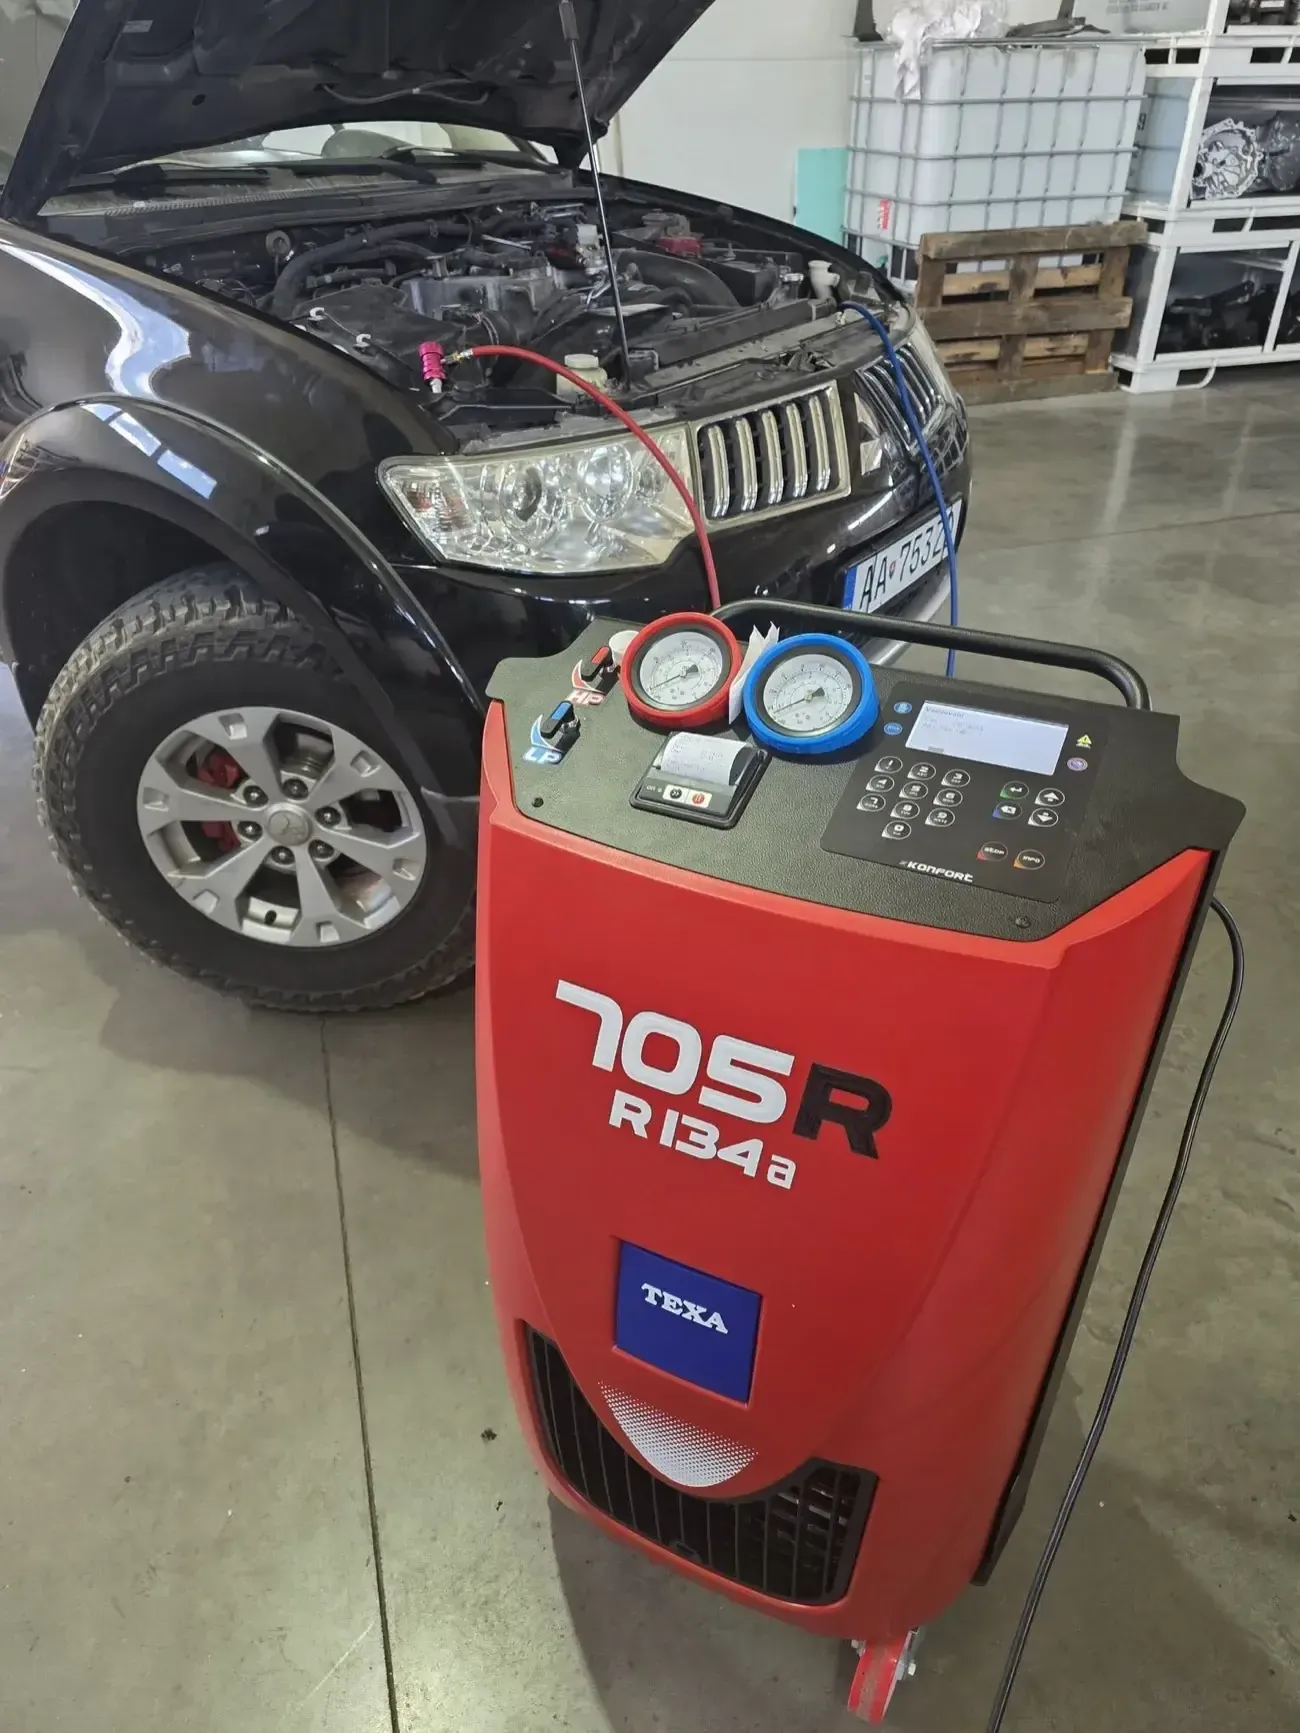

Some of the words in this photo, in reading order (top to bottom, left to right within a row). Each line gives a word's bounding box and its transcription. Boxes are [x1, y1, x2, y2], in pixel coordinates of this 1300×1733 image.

[860, 555, 888, 610] AA
[523, 746, 563, 764] LP
[919, 765, 929, 773] 2
[953, 772, 963, 780] 3
[870, 797, 879, 805] 7
[903, 804, 912, 812] 8
[937, 811, 947, 819] 9
[893, 824, 904, 832] 0
[640, 1282, 729, 1334] TEXA
